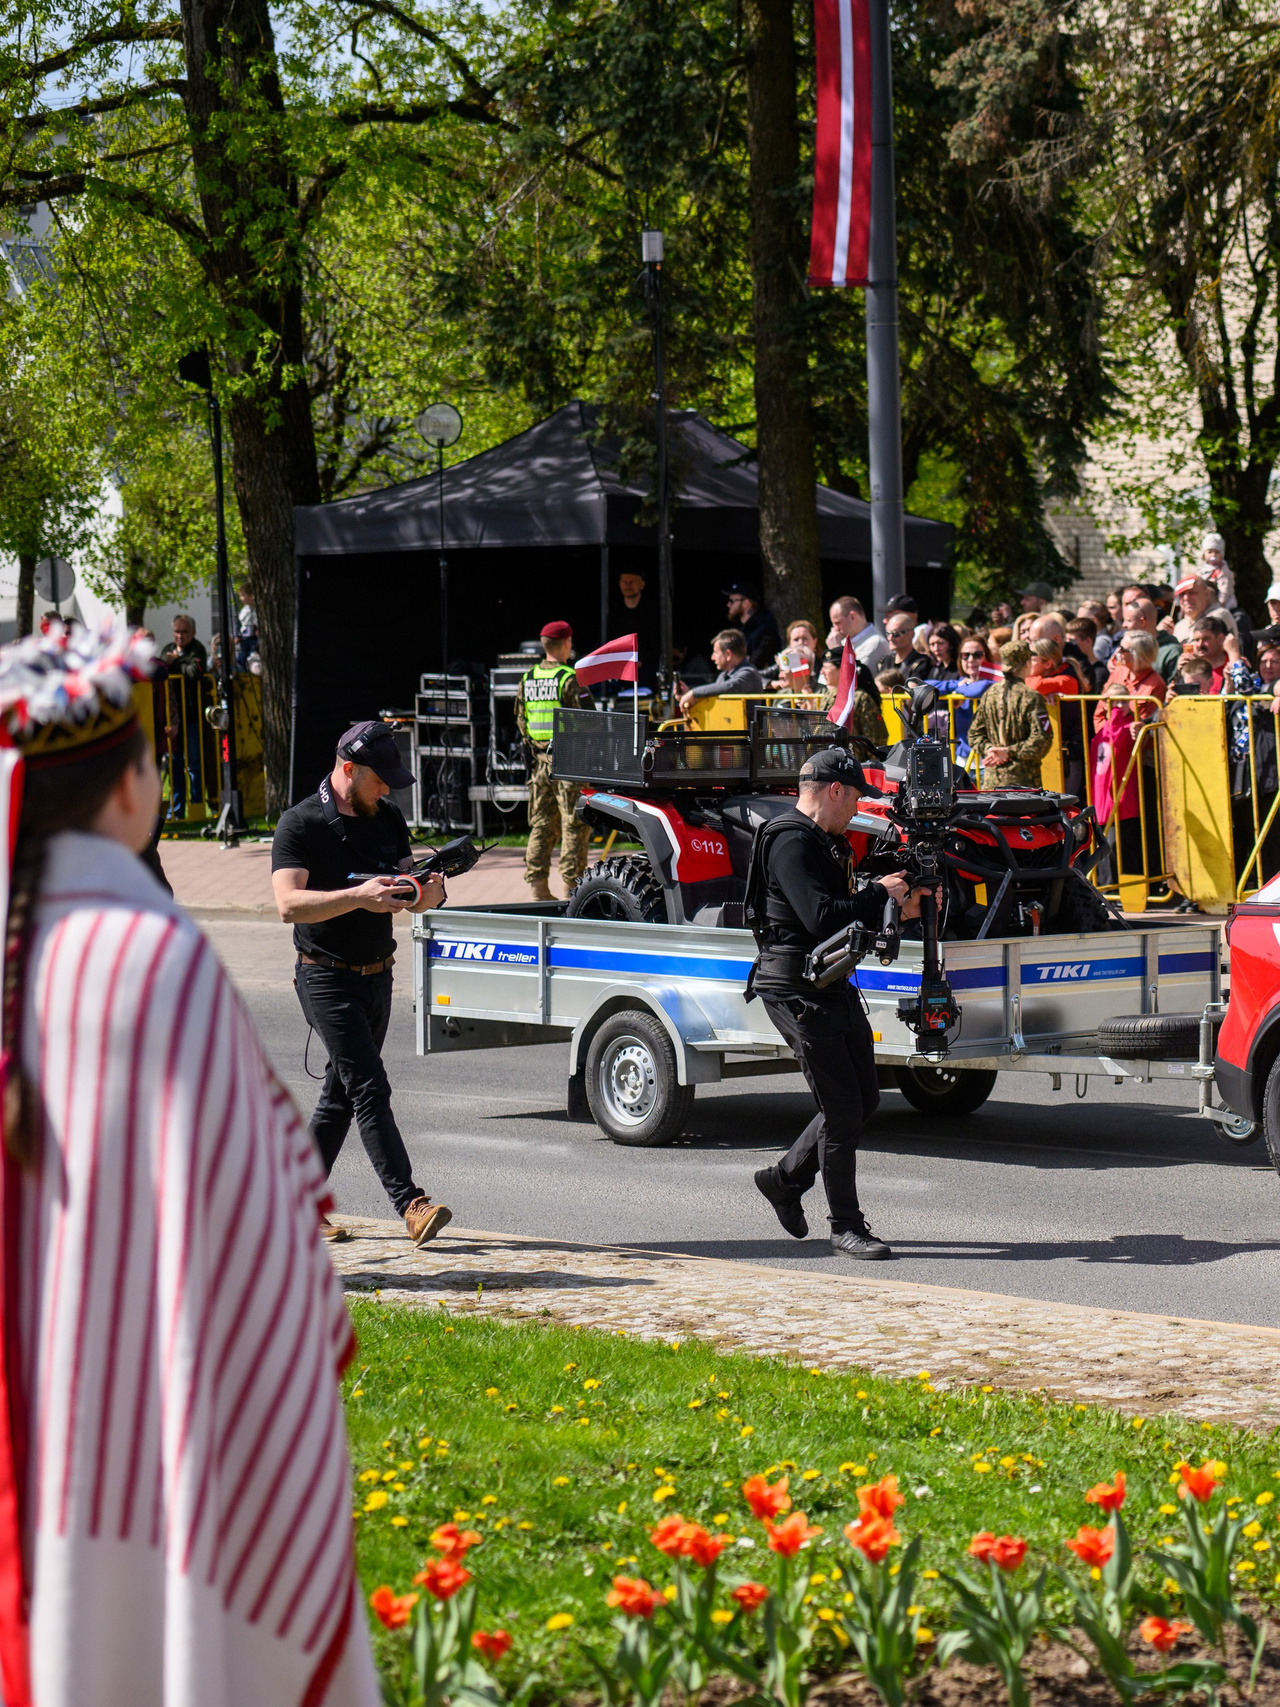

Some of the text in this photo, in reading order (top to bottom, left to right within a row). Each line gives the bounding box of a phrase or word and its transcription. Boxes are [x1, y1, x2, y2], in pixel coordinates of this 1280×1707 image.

[525, 686, 558, 701] POLICIJA
[702, 839, 724, 855] 112
[438, 941, 536, 963] TIKI treiler
[1037, 964, 1091, 980] TIKI
